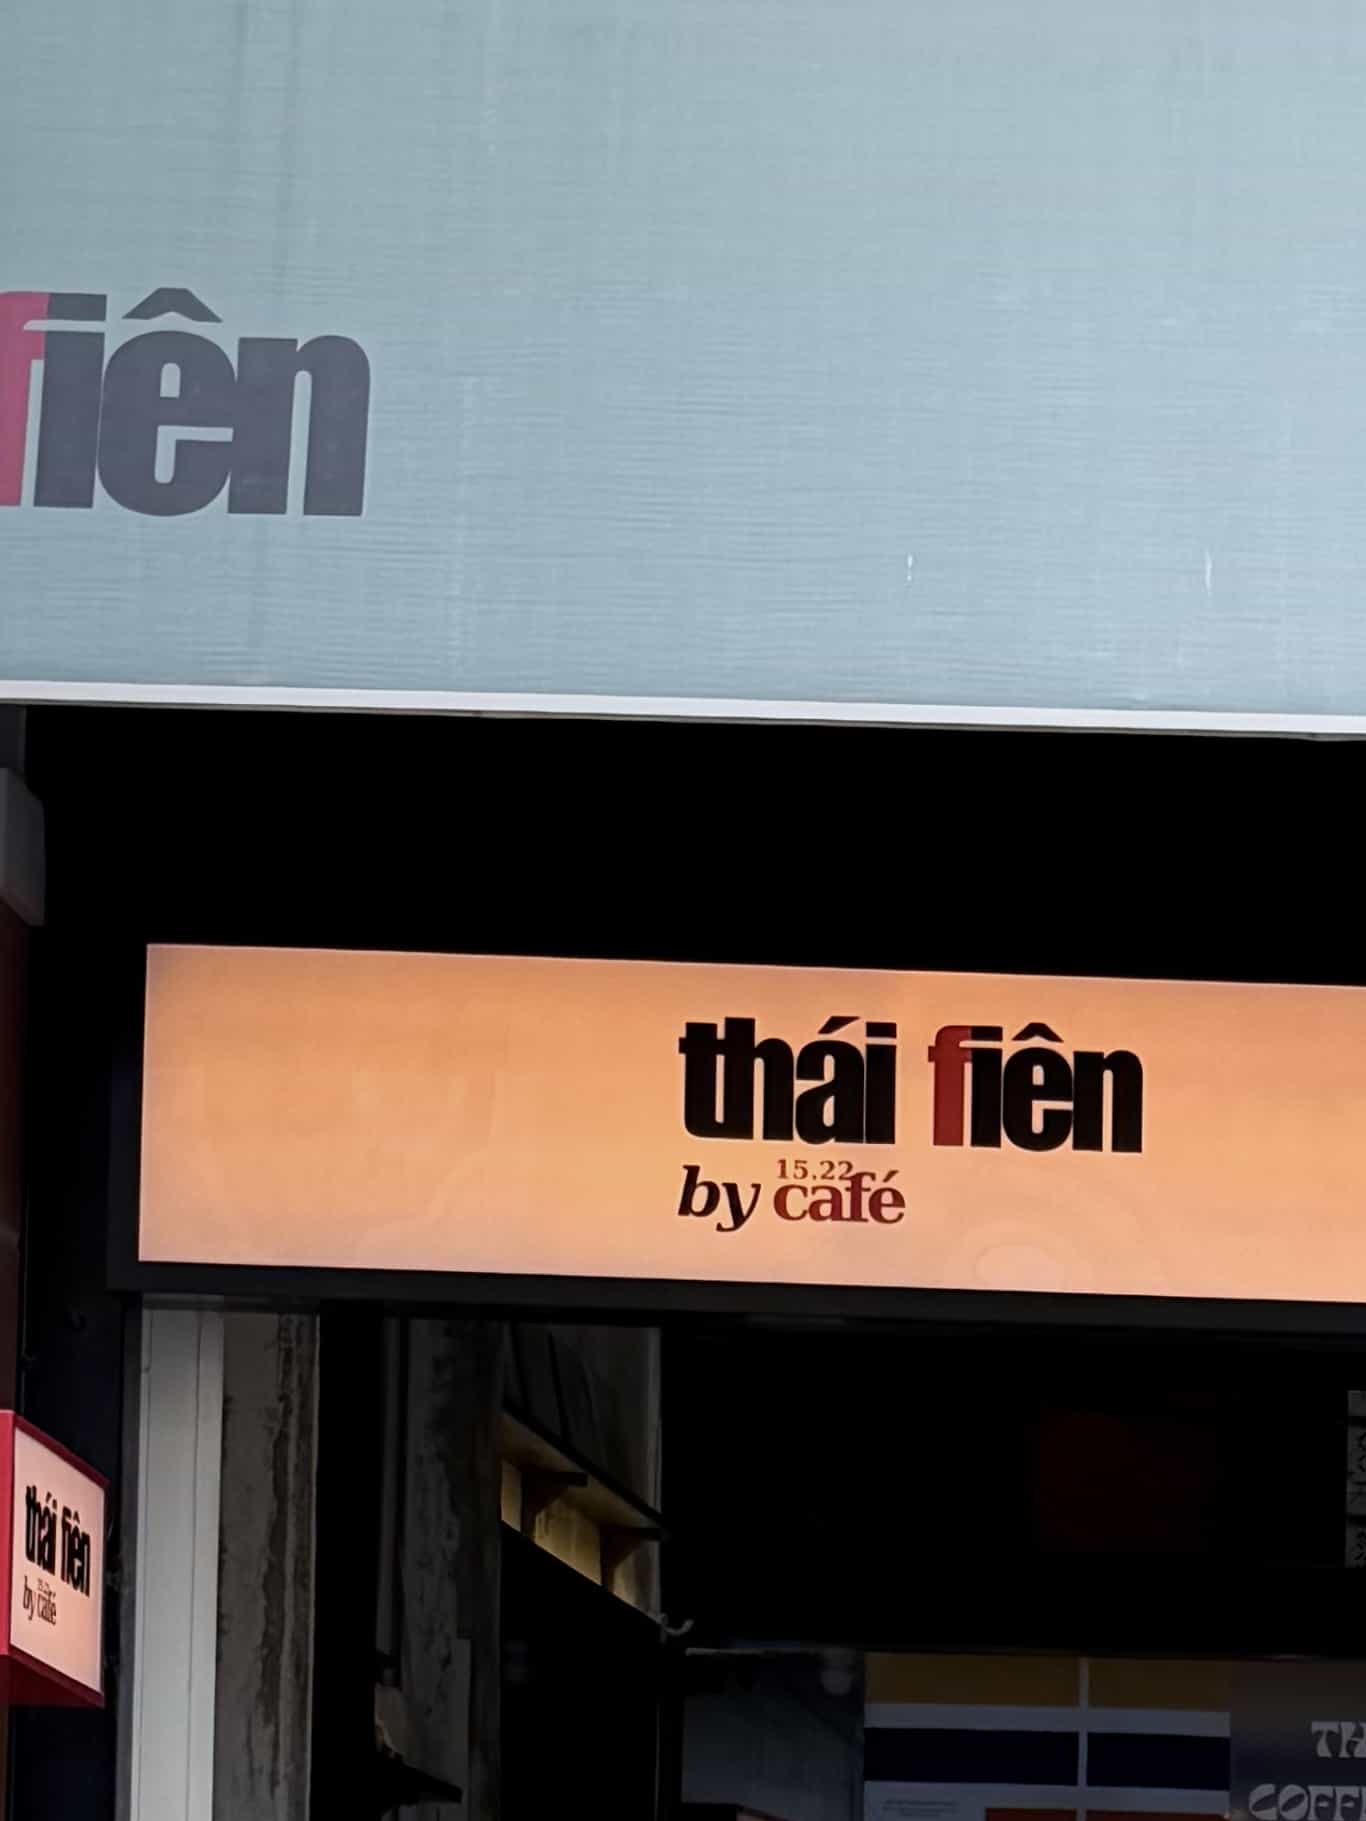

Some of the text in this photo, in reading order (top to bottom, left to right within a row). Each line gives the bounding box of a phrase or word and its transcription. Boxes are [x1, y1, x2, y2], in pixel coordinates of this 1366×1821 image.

[678, 1015, 1144, 1154] thái fiên
[677, 1159, 906, 1233] by 15.22 café
[25, 1485, 57, 1576] thái
